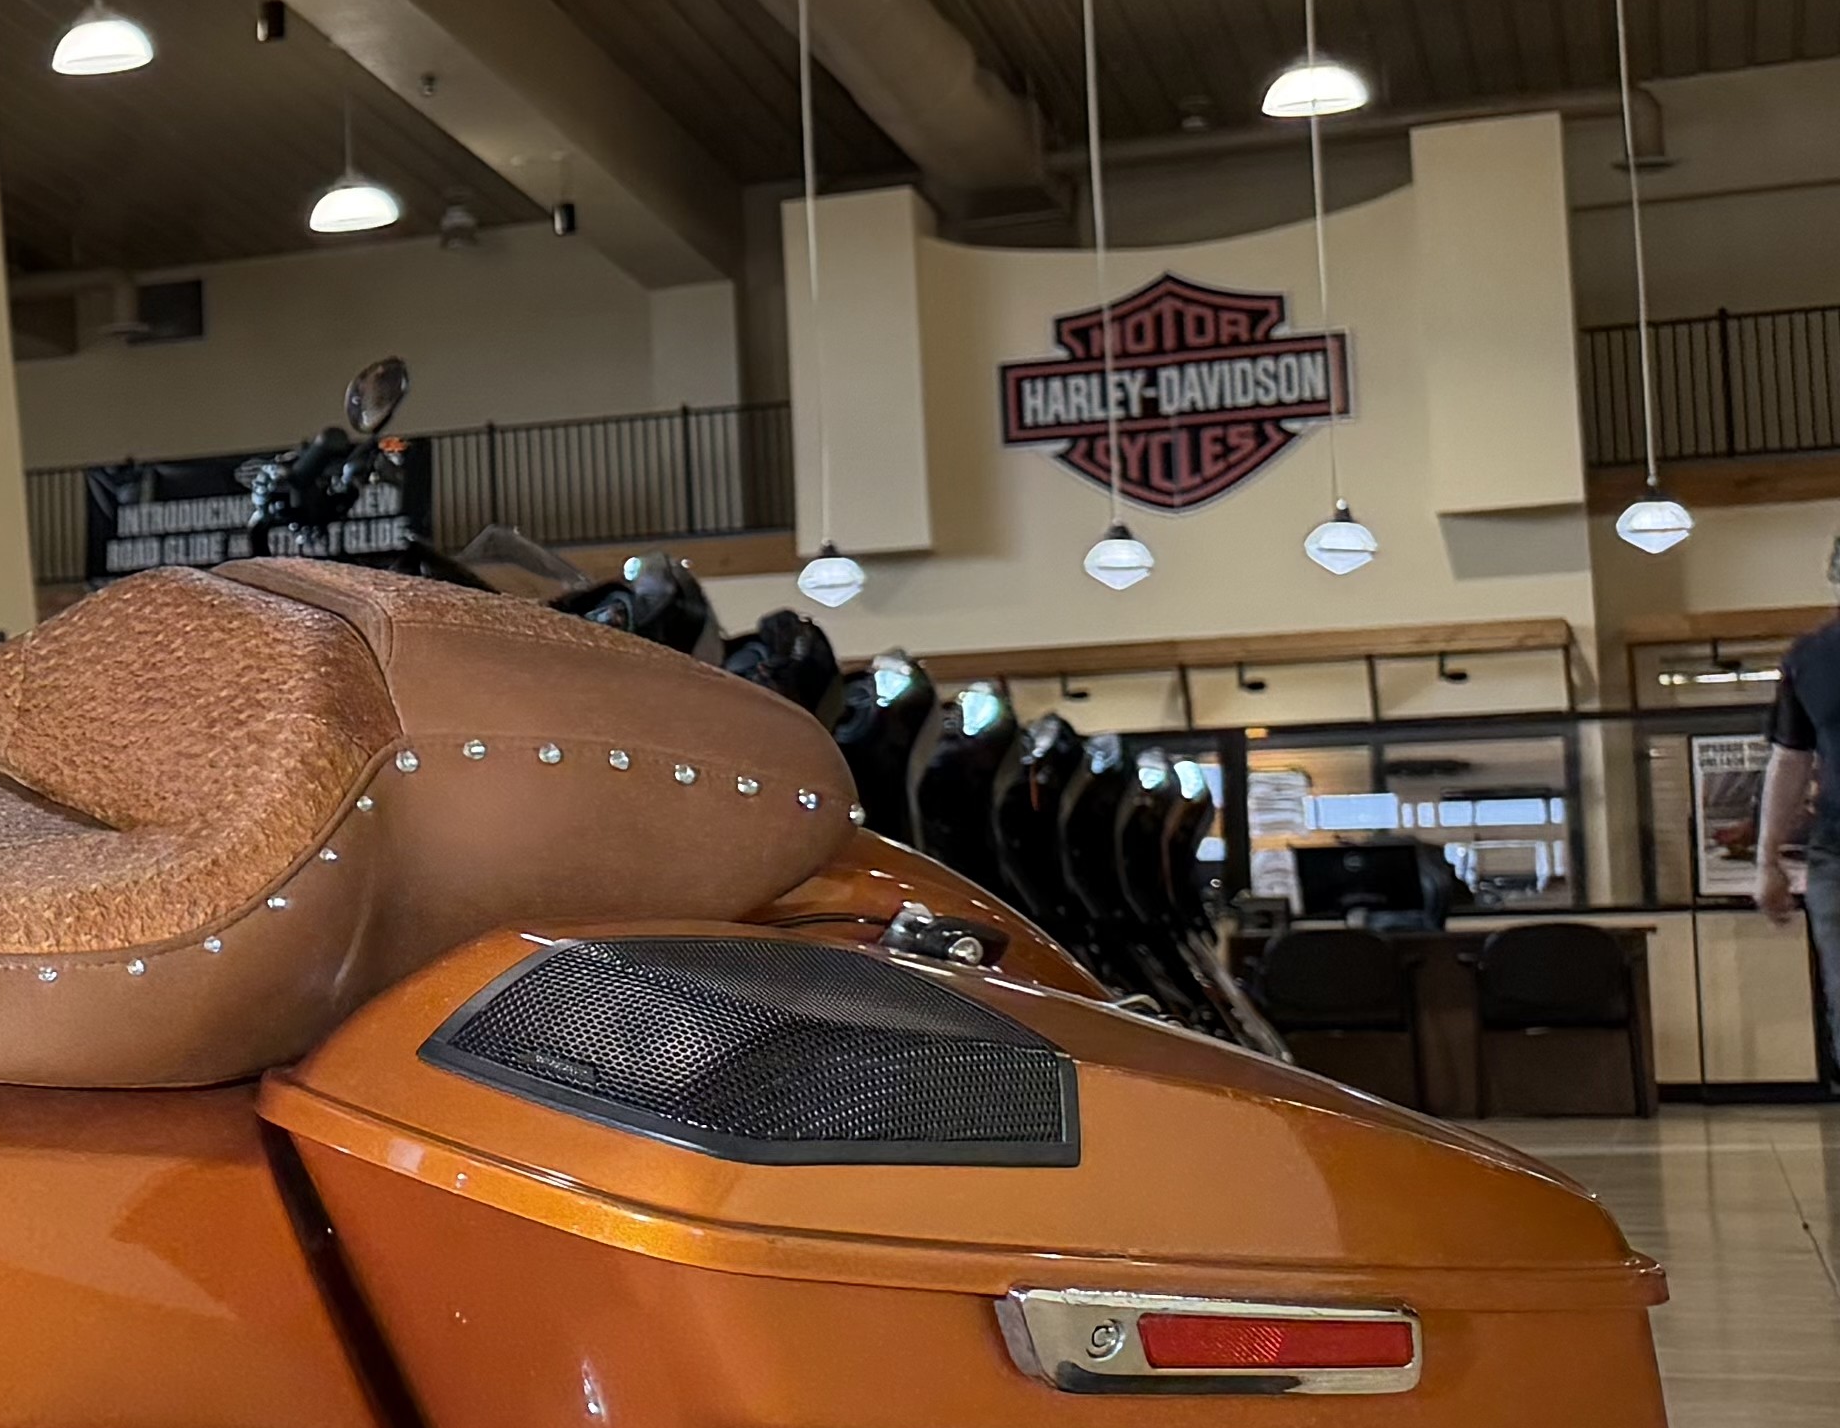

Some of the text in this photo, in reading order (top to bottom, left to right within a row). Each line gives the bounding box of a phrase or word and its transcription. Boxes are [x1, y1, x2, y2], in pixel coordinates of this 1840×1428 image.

[1089, 298, 1251, 357] MOTOR
[1022, 351, 1327, 427] HARLEY-DAVIDSON
[1093, 422, 1258, 493] CYCLES
